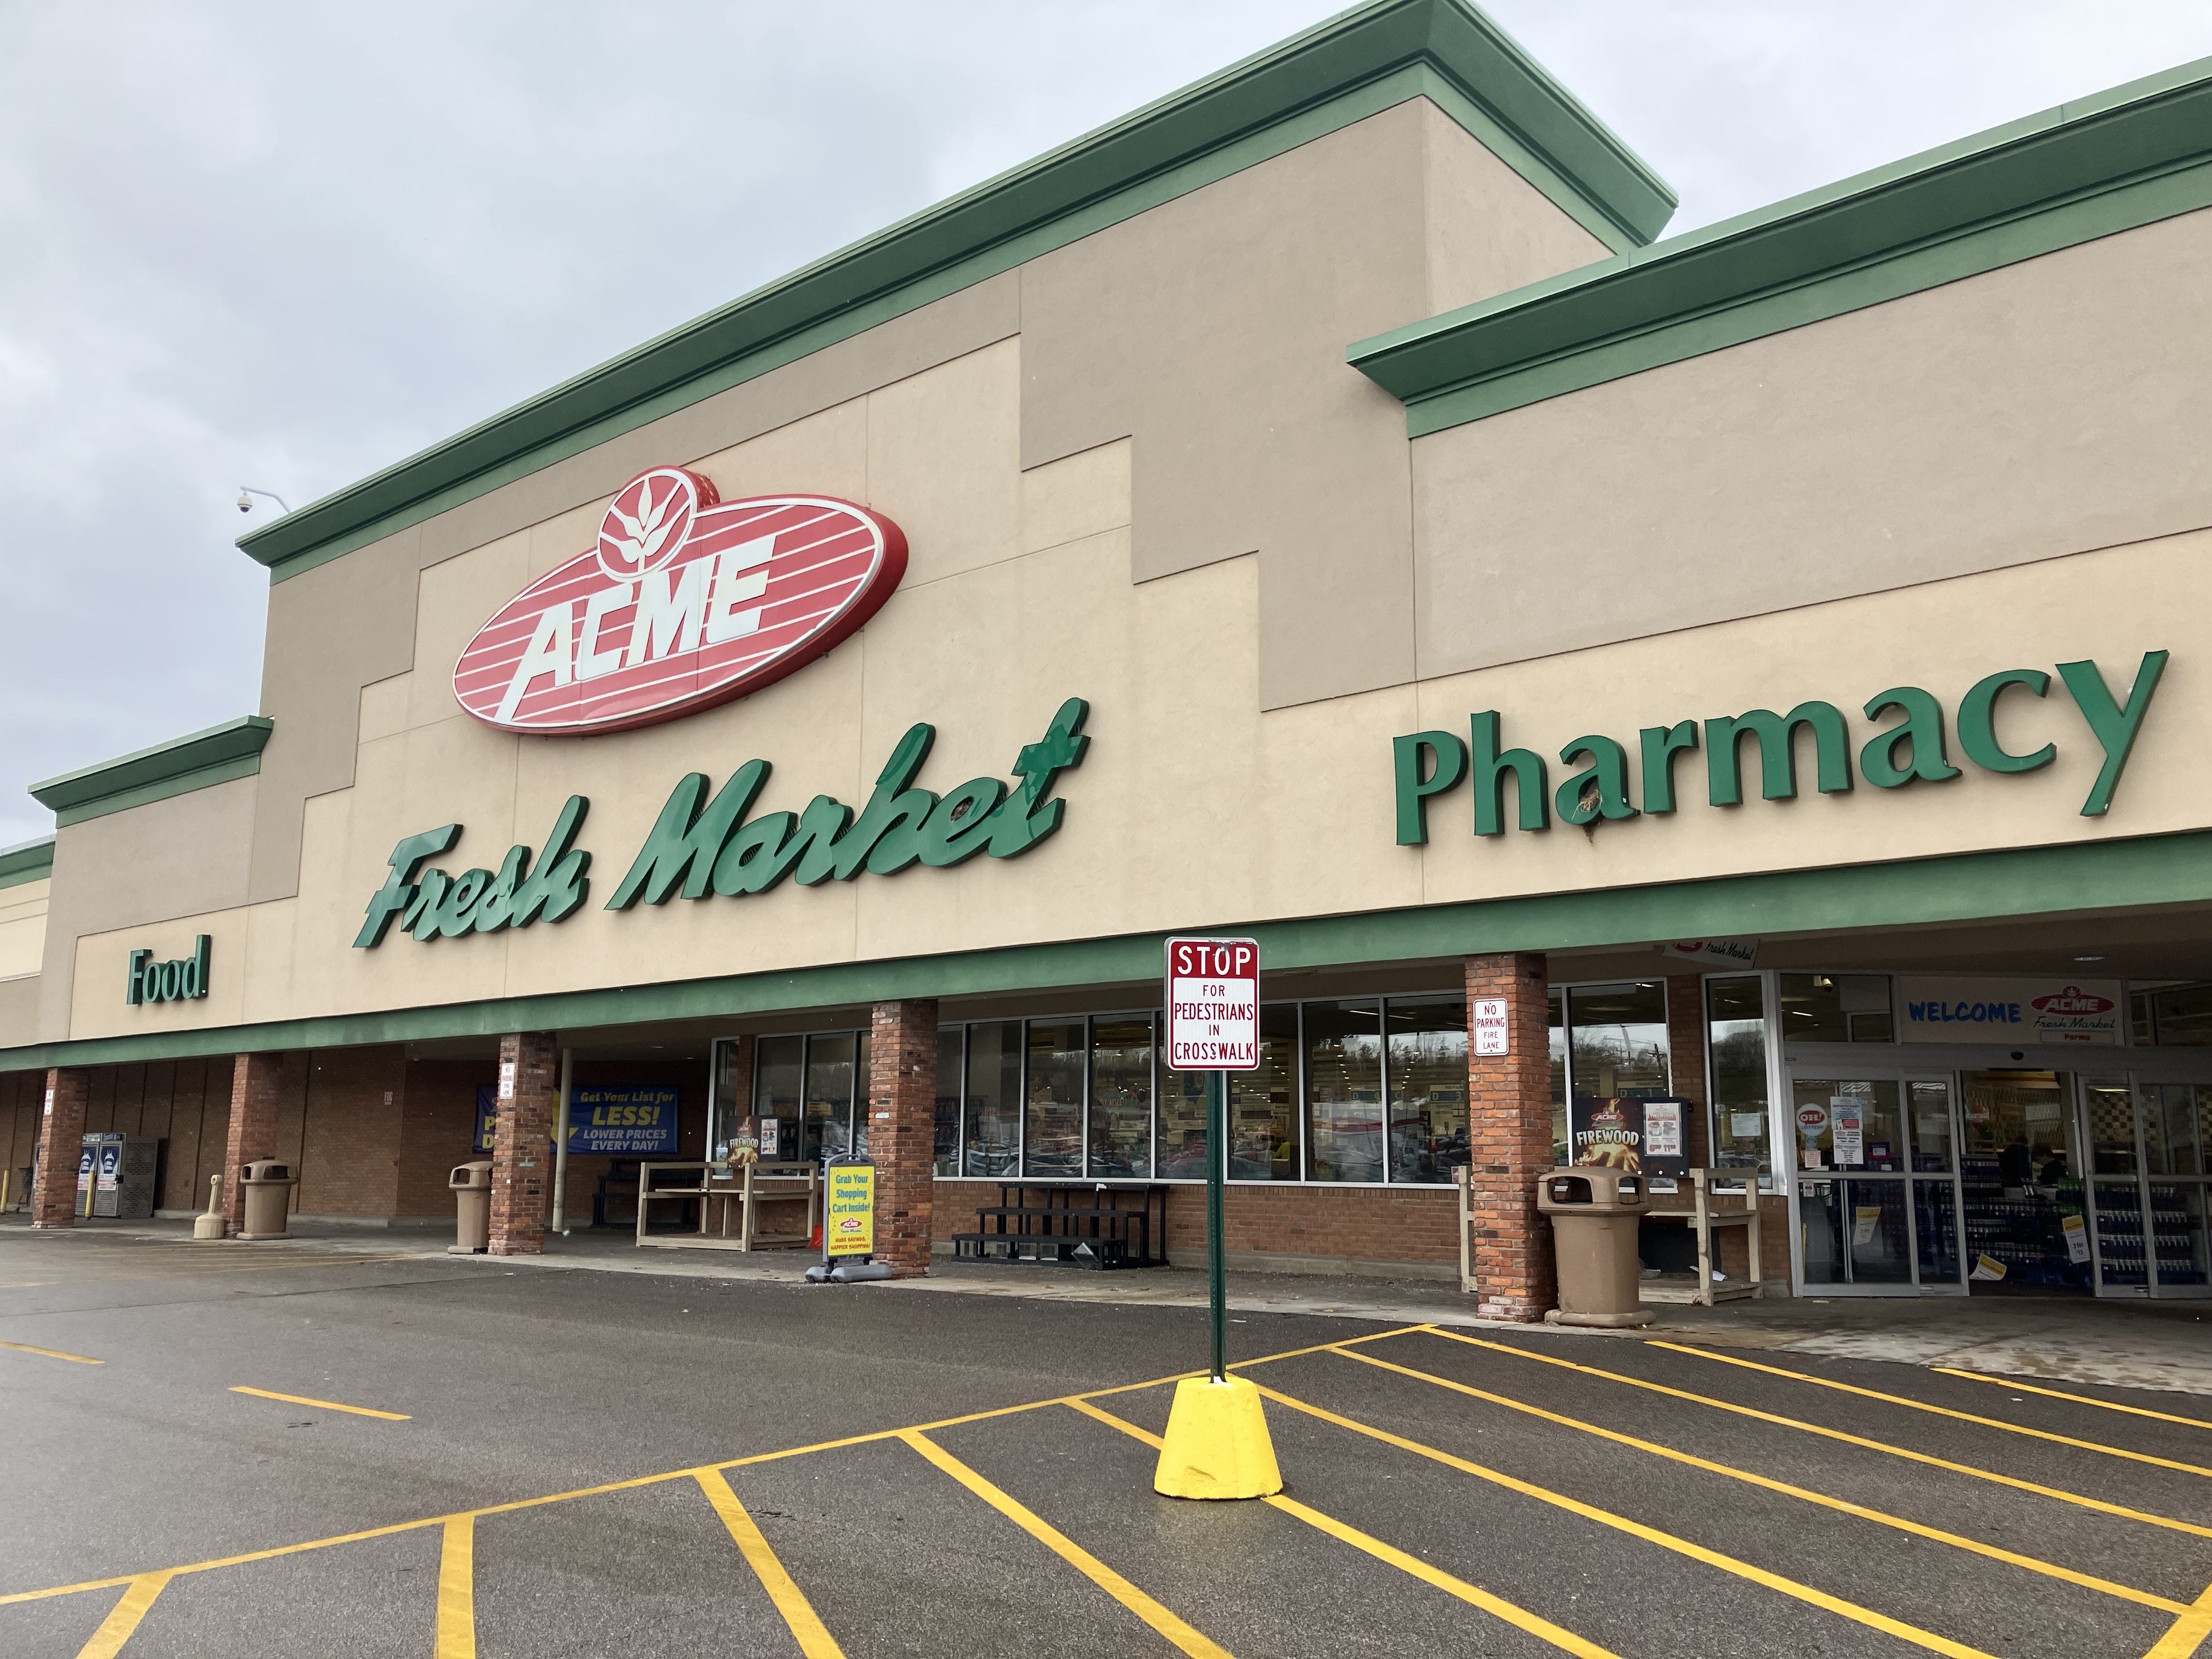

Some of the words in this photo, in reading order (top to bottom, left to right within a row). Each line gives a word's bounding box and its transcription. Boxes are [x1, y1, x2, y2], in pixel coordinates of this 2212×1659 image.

[493, 533, 777, 723] ACME
[1393, 649, 2170, 845] Pharmacy
[352, 794, 592, 949] Fresh
[605, 697, 1091, 911] Market
[1725, 943, 1754, 960] Market
[1177, 945, 1251, 975] STOP
[126, 934, 211, 1005] Food
[1203, 985, 1225, 996] FOR
[1175, 1003, 1254, 1020] PEDESTRIANS
[1485, 1005, 1496, 1015] NO
[1909, 1001, 2022, 1023] WELCOME
[2042, 998, 2099, 1013] ACME
[1477, 1017, 1505, 1028] PARKING
[2033, 1016, 2067, 1028] Fresh
[2069, 1017, 2116, 1029] Market
[1209, 1024, 1220, 1036] IN
[1175, 1042, 1254, 1060] CROSSWALK
[580, 1092, 600, 1102] Get
[604, 1092, 628, 1102] Your
[631, 1091, 653, 1102] List
[654, 1092, 674, 1104] for
[592, 1106, 661, 1126] LESS!
[1800, 1113, 1822, 1121] OH!
[583, 1129, 625, 1139] LOWER
[626, 1129, 667, 1139] PRICES
[1576, 1130, 1639, 1146] FIREWOOD
[591, 1141, 630, 1150] EVERY
[631, 1141, 658, 1150] DAY!
[730, 1138, 759, 1149] FIREWOOD
[836, 1175, 851, 1183] Grab
[854, 1174, 868, 1183] Your
[836, 1188, 867, 1200] Shopping
[833, 1203, 847, 1212] Cart
[849, 1202, 870, 1211] Inside!
